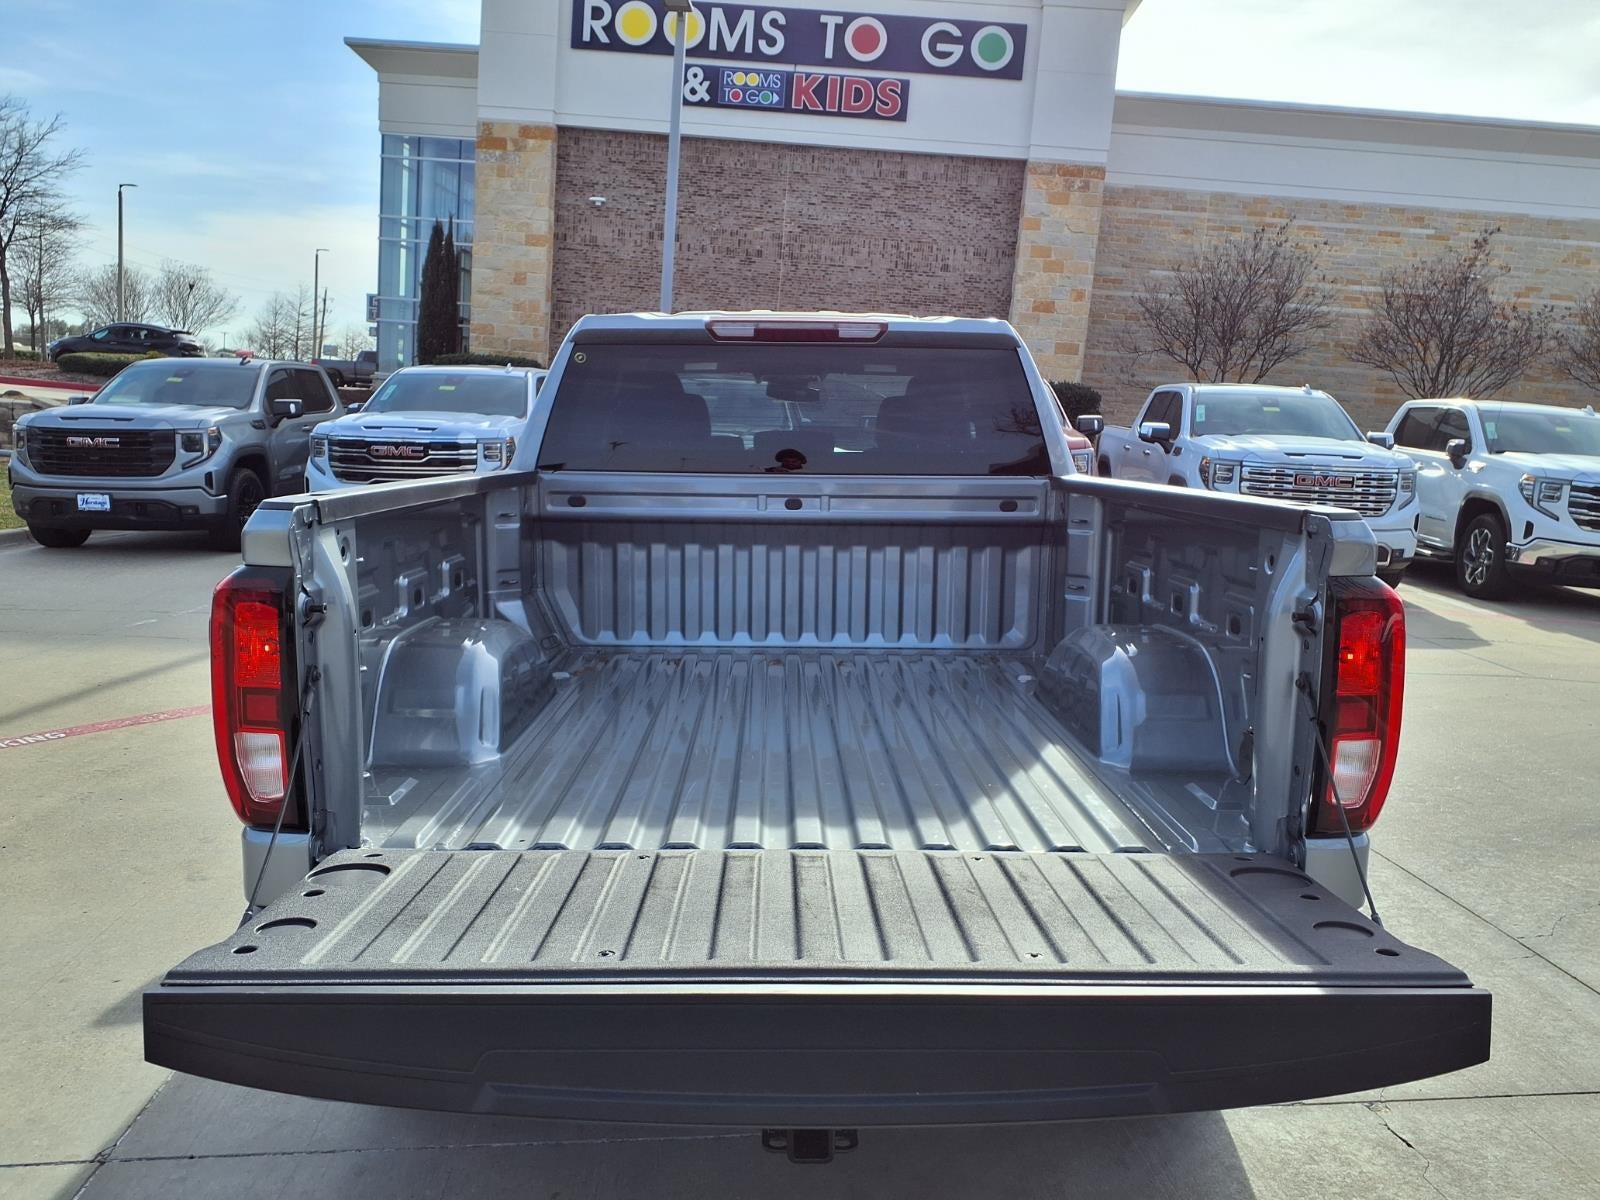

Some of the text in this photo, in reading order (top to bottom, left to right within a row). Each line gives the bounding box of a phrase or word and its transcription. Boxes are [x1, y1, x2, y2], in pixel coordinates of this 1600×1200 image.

[582, 0, 1014, 71] ROOMS TO GO
[683, 66, 711, 102] &
[723, 70, 781, 89] ROOMS
[723, 87, 773, 104] TO GO
[792, 73, 902, 117] KIDS
[67, 437, 119, 448] GMC
[370, 445, 424, 457] GMC
[1297, 474, 1353, 487] GMC
